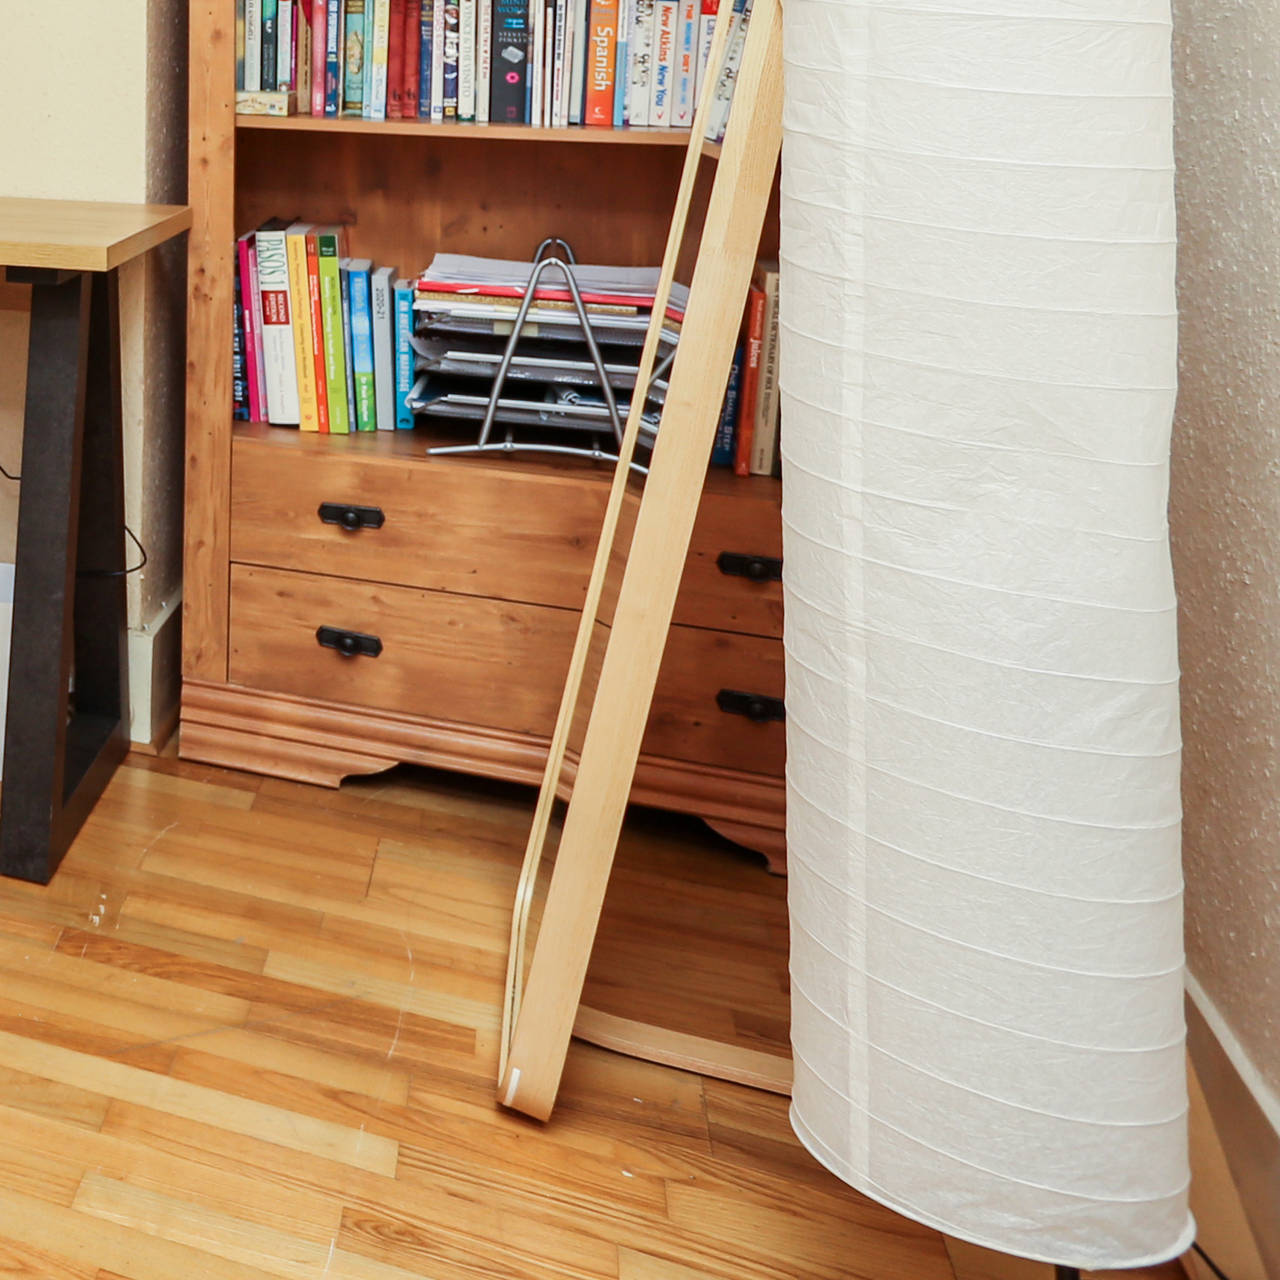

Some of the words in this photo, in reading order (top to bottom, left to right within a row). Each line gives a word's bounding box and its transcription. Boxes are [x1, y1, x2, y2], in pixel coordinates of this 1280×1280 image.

[661, 5, 673, 26] New
[686, 3, 694, 20] THE
[658, 29, 672, 62] Atkins
[594, 26, 615, 91] Spanish
[682, 54, 691, 73] DIET
[657, 64, 669, 86] New
[655, 88, 667, 106] You
[257, 238, 286, 276] PASOS
[375, 287, 386, 320] 2020-21
[399, 300, 410, 311] AN
[399, 313, 410, 352] AMERICAN
[767, 320, 779, 364] DICTIONARY
[750, 338, 762, 368] juices
[233, 354, 241, 377] BIBLE
[399, 354, 411, 392] MARRIAGE
[234, 380, 243, 402] CODE
[361, 376, 367, 384] Dr
